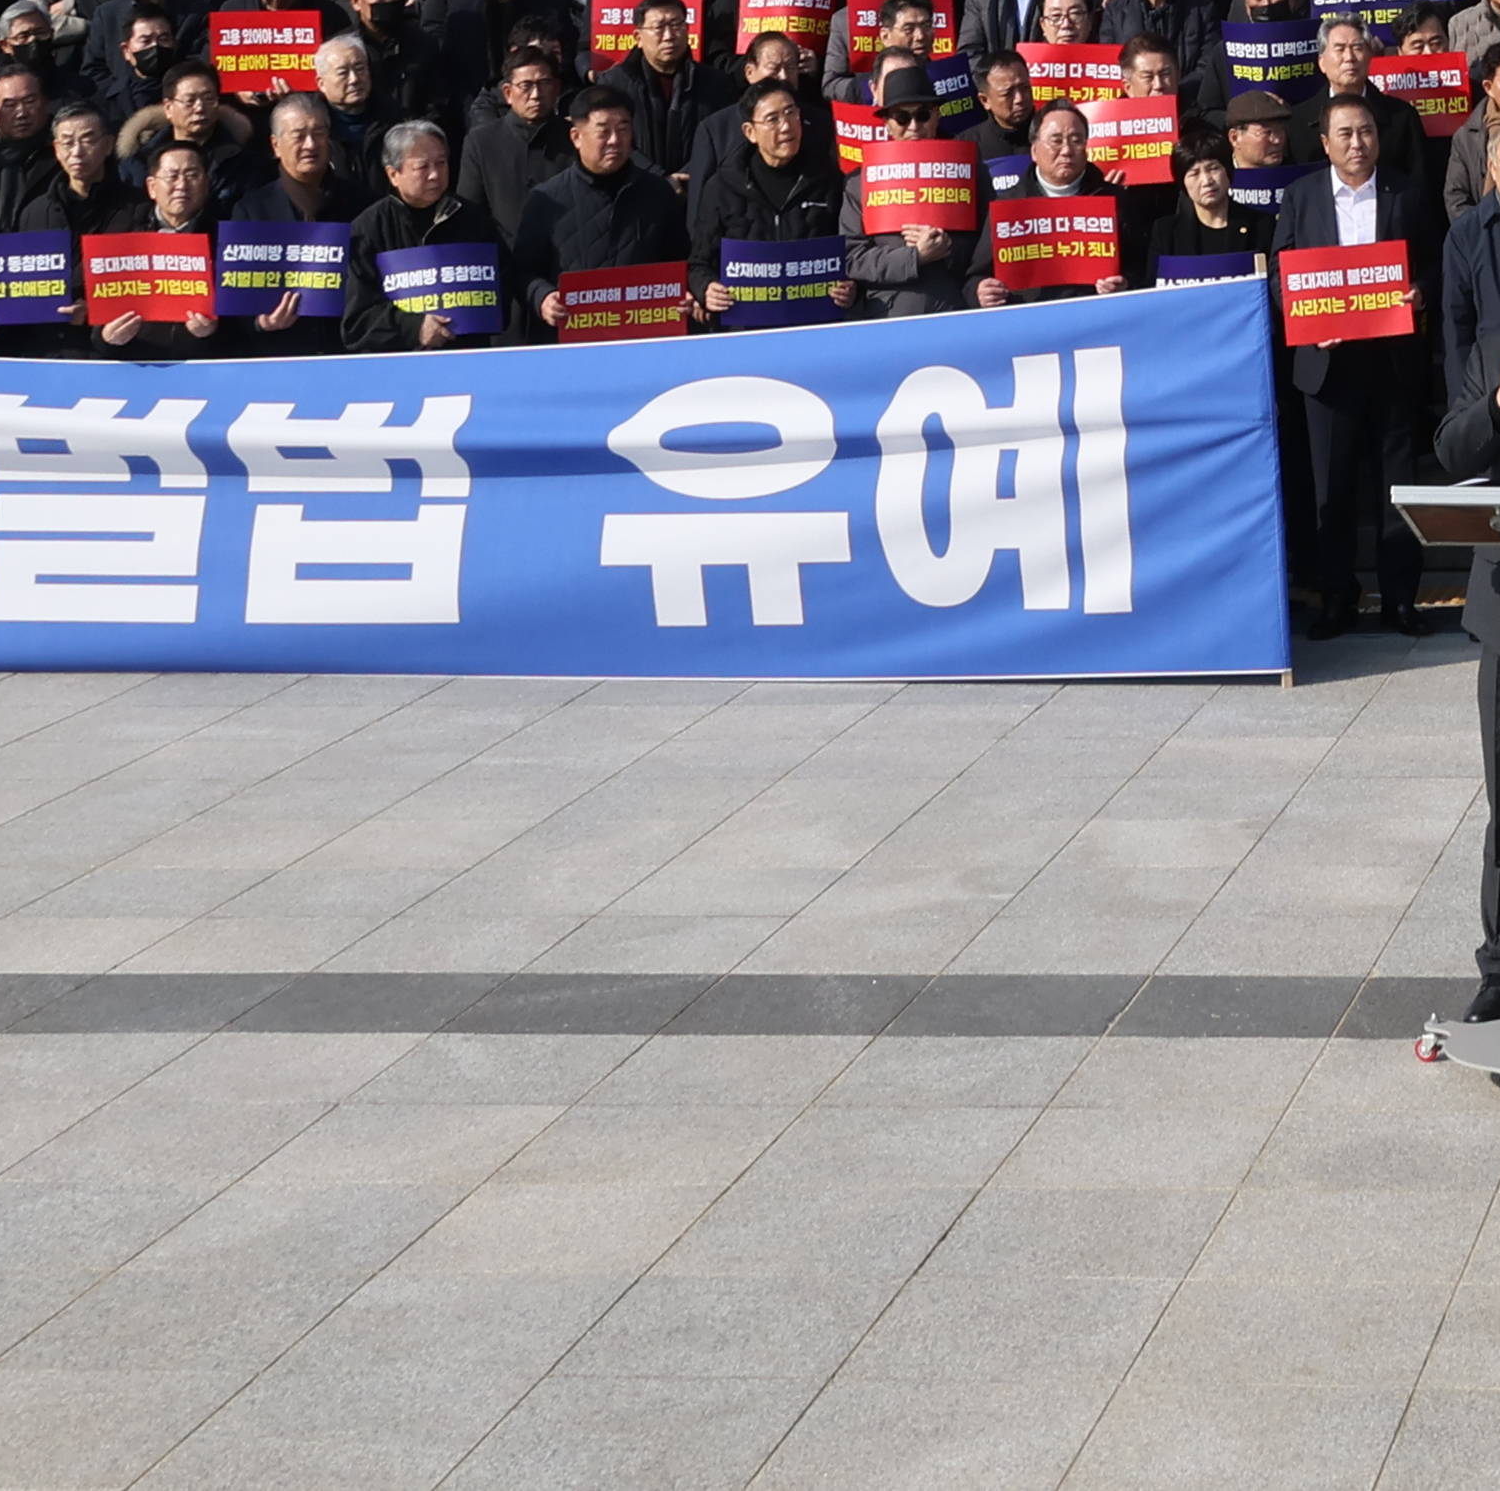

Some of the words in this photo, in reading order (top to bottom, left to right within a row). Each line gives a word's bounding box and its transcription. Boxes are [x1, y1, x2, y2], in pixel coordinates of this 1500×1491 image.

[867, 163, 915, 182] 중대재해
[918, 162, 970, 178] 불안감에
[867, 189, 915, 206] 사라지는
[919, 187, 970, 203] 기업의욕
[996, 218, 1052, 238] 중소기업
[1056, 217, 1070, 232] 다
[1073, 217, 1113, 233] 죽으면
[223, 245, 283, 261] 산재예방
[286, 245, 344, 262] 동참한다
[999, 243, 1053, 262] 아파트는
[1058, 241, 1085, 257] 누가
[1088, 242, 1115, 257] 짓나
[8, 254, 65, 272] 동참한다
[91, 255, 149, 274] 중대재해
[152, 255, 206, 271] 불안감에
[221, 271, 281, 287] 처벌불안
[285, 271, 341, 288] 없애달라
[384, 268, 437, 292] 산재예방
[440, 266, 494, 283] 동참한다
[1288, 270, 1343, 291] 중대재해
[1347, 265, 1402, 285] 불안감에
[9, 280, 65, 297] 없애달라
[93, 280, 151, 297] 사라지는
[155, 280, 208, 296] 기업의욕
[1290, 297, 1345, 316] 사라지는
[1349, 291, 1408, 310] 기업의욕
[599, 346, 1133, 627] 유예
